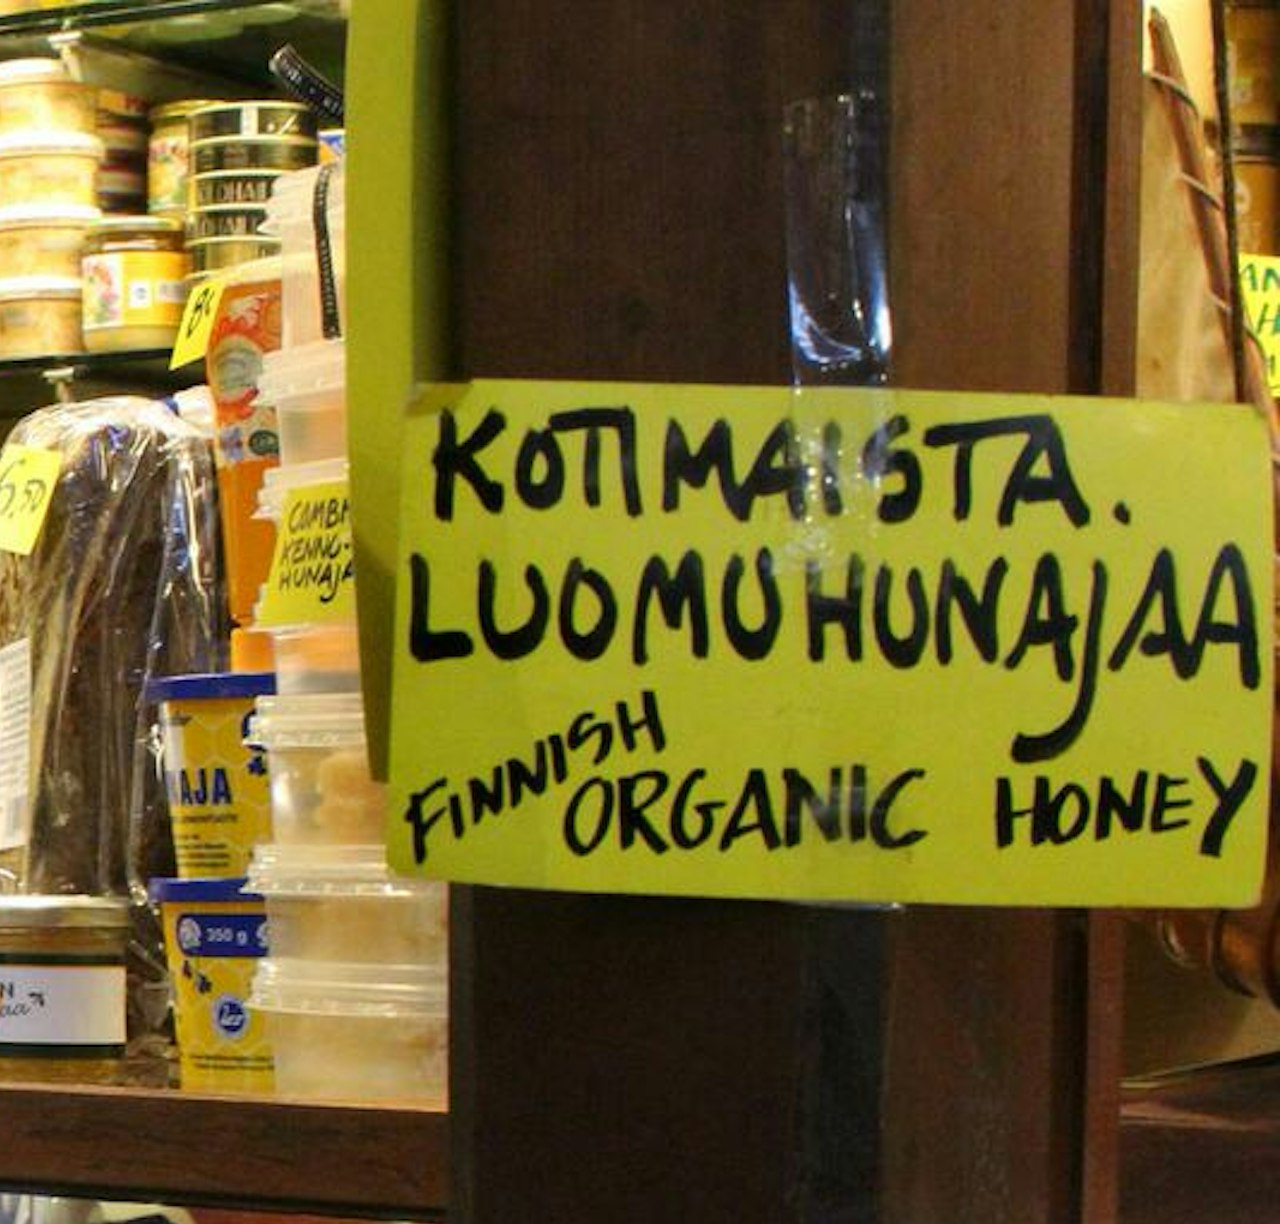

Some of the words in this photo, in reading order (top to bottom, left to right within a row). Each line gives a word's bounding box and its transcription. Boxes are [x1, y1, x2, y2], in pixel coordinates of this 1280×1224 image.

[404, 688, 666, 862] FINNISH
[563, 763, 929, 857] ORGANIC
[993, 755, 1259, 859] HONEY
